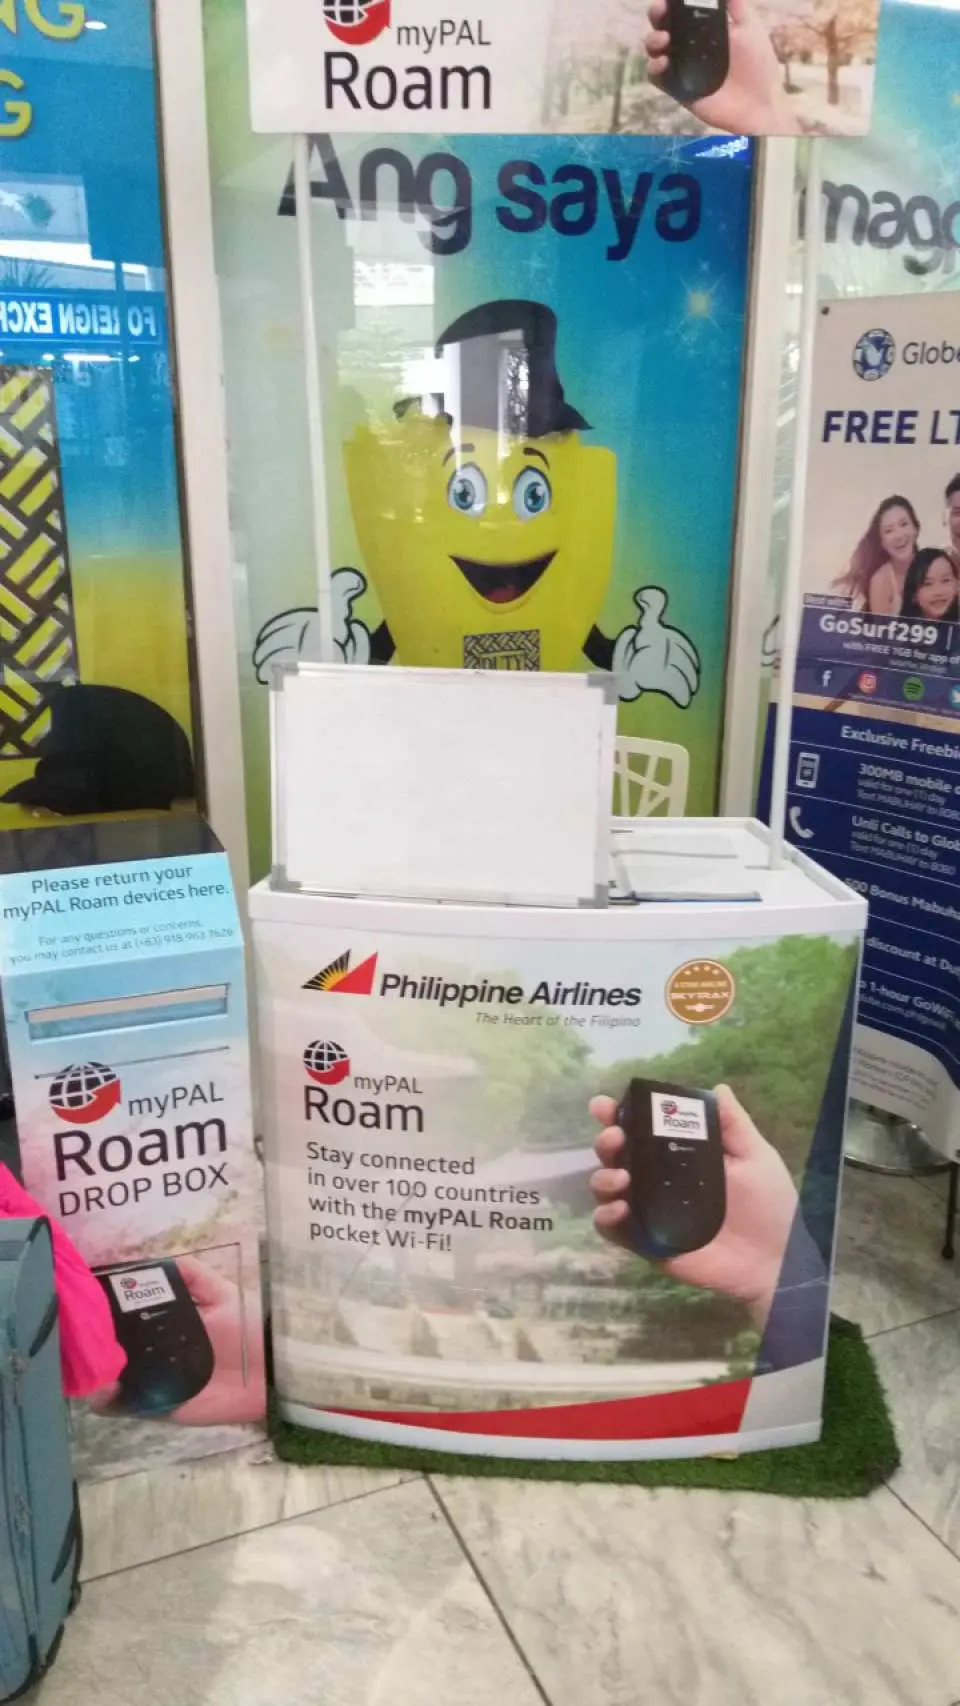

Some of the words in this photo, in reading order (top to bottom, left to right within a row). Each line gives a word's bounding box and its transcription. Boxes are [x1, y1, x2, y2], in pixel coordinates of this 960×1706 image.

[396, 19, 491, 53] myPAL
[324, 51, 490, 110] Roam
[277, 133, 472, 256] Ang
[496, 159, 701, 261] saya
[821, 409, 919, 445] FREE
[819, 613, 939, 645] GoSurf299
[840, 725, 909, 750] Exclusive
[858, 763, 904, 782] 300MB
[905, 775, 953, 793] mobile
[914, 831, 929, 843] to
[31, 873, 90, 895] Please
[95, 871, 150, 887] return
[154, 866, 193, 882] your
[869, 884, 911, 906] Bonus
[3, 900, 66, 922] myPAL
[69, 895, 119, 913] Roam
[123, 886, 186, 905] devices
[188, 883, 230, 900] here.
[61, 943, 103, 959] contact
[83, 926, 137, 943] questions
[380, 973, 524, 1008] Philippine
[528, 981, 642, 1006] Airlines
[475, 1012, 500, 1025] The
[503, 1013, 543, 1027] Heart
[546, 1013, 561, 1027] of
[563, 1014, 586, 1028] the
[589, 1015, 642, 1031] Filipino
[127, 1081, 225, 1119] myPAL
[354, 1075, 424, 1096] myPAL
[304, 1085, 424, 1133] Roam
[52, 1117, 229, 1182] Roam
[306, 1141, 354, 1170] Stay
[359, 1152, 476, 1175] connected
[58, 1177, 153, 1217] DROP
[162, 1162, 231, 1197] BOX
[307, 1167, 327, 1186] in
[332, 1176, 381, 1194] over
[386, 1178, 428, 1198] 100
[434, 1184, 541, 1205] countries
[308, 1195, 356, 1217] with
[362, 1201, 398, 1222] the
[403, 1207, 483, 1230] myPAL
[488, 1210, 554, 1232] Roam
[309, 1222, 381, 1246] pocket
[387, 1229, 452, 1252] Wi-Fi!
[123, 1286, 166, 1302] Roam
